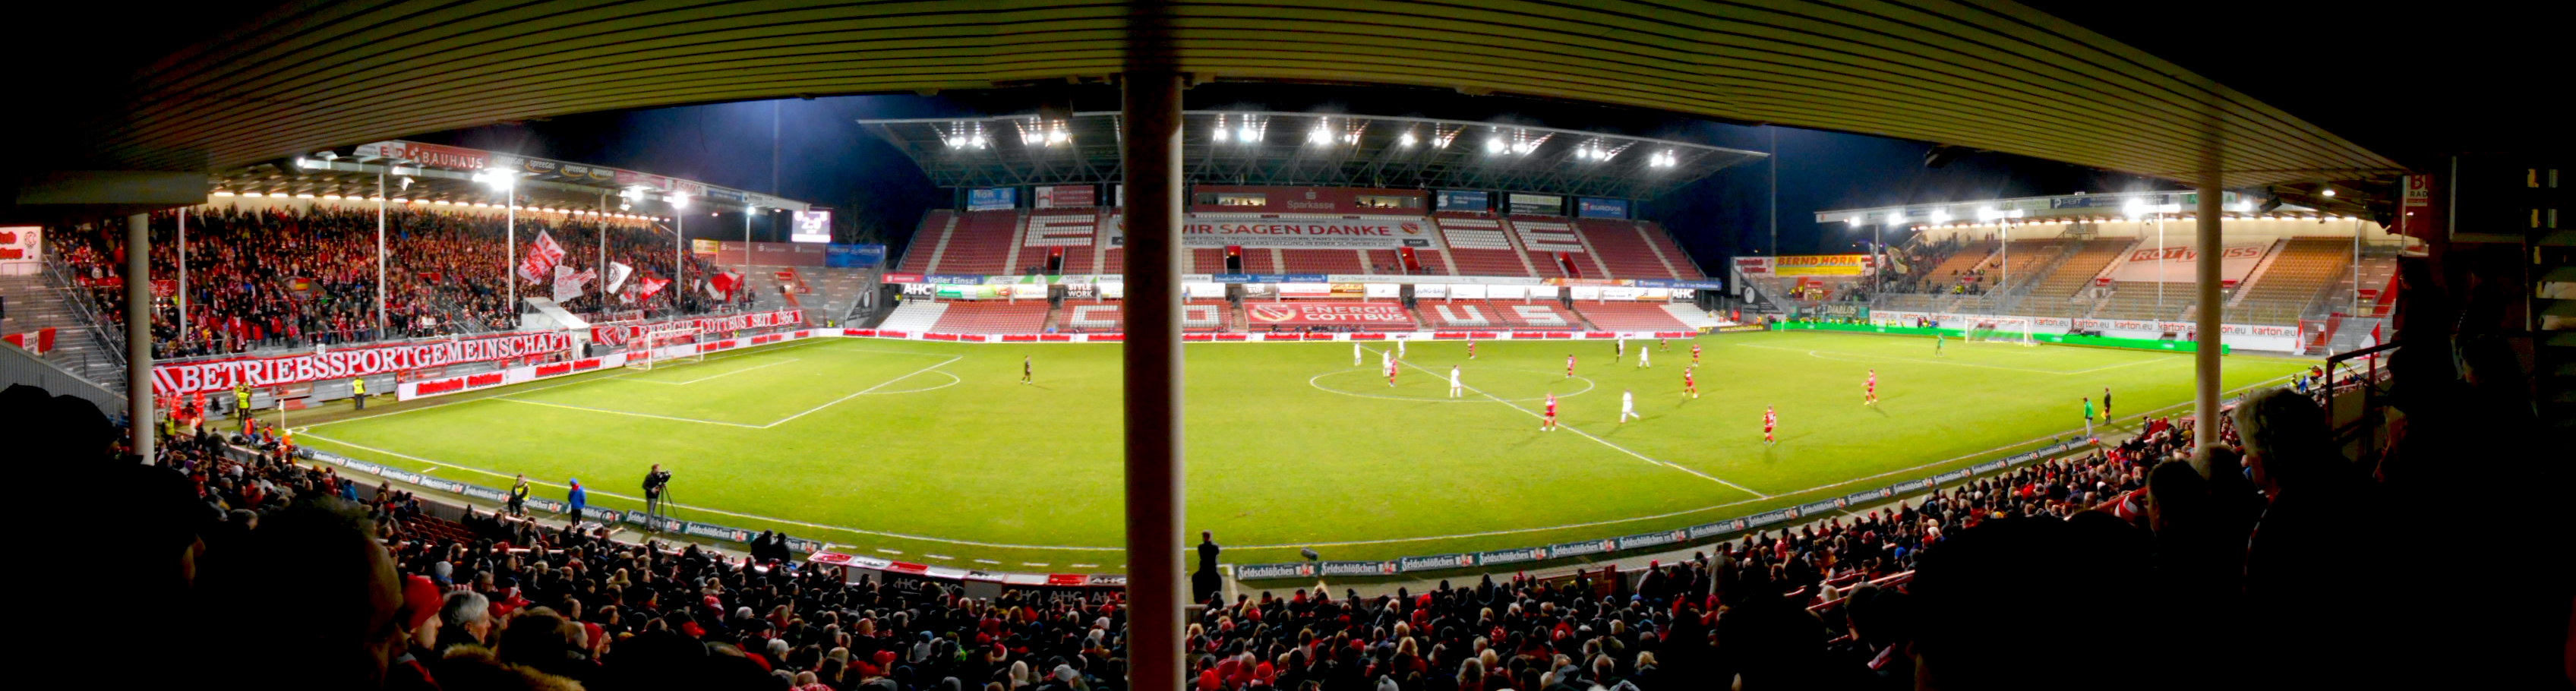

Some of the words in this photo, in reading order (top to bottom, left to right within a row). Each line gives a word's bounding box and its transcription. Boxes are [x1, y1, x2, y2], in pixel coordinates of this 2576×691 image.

[422, 152, 484, 169] BAUHAUS
[1287, 200, 1335, 210] Sparkasse
[1220, 224, 1301, 235] SAGEN
[1308, 225, 1392, 236] DANKE
[1778, 256, 1819, 266] BERND
[1823, 256, 1858, 265] HORN
[903, 283, 931, 295] AHC
[1673, 289, 1695, 298] AHC
[1302, 306, 1400, 314] ENERGIE
[1826, 305, 1857, 314] DIABLOS
[701, 315, 747, 333] COTTBUS
[751, 313, 772, 327] SEIT
[778, 312, 794, 325] 1966
[2035, 317, 2069, 327] karton.eu
[2073, 319, 2110, 329] karton.eu
[2114, 320, 2153, 331] karton.eu
[2252, 324, 2297, 336] karton.eu
[179, 332, 570, 391] BETRIEBSSPORTGEMEINSCHAFT
[1402, 556, 1454, 572] Feldschlößchen
[1480, 551, 1529, 566] Feldschlößchen
[1238, 563, 1294, 580] Feldschlößchen
[1321, 561, 1376, 576] Feldschlößchen
[1047, 590, 1082, 603] AHC
